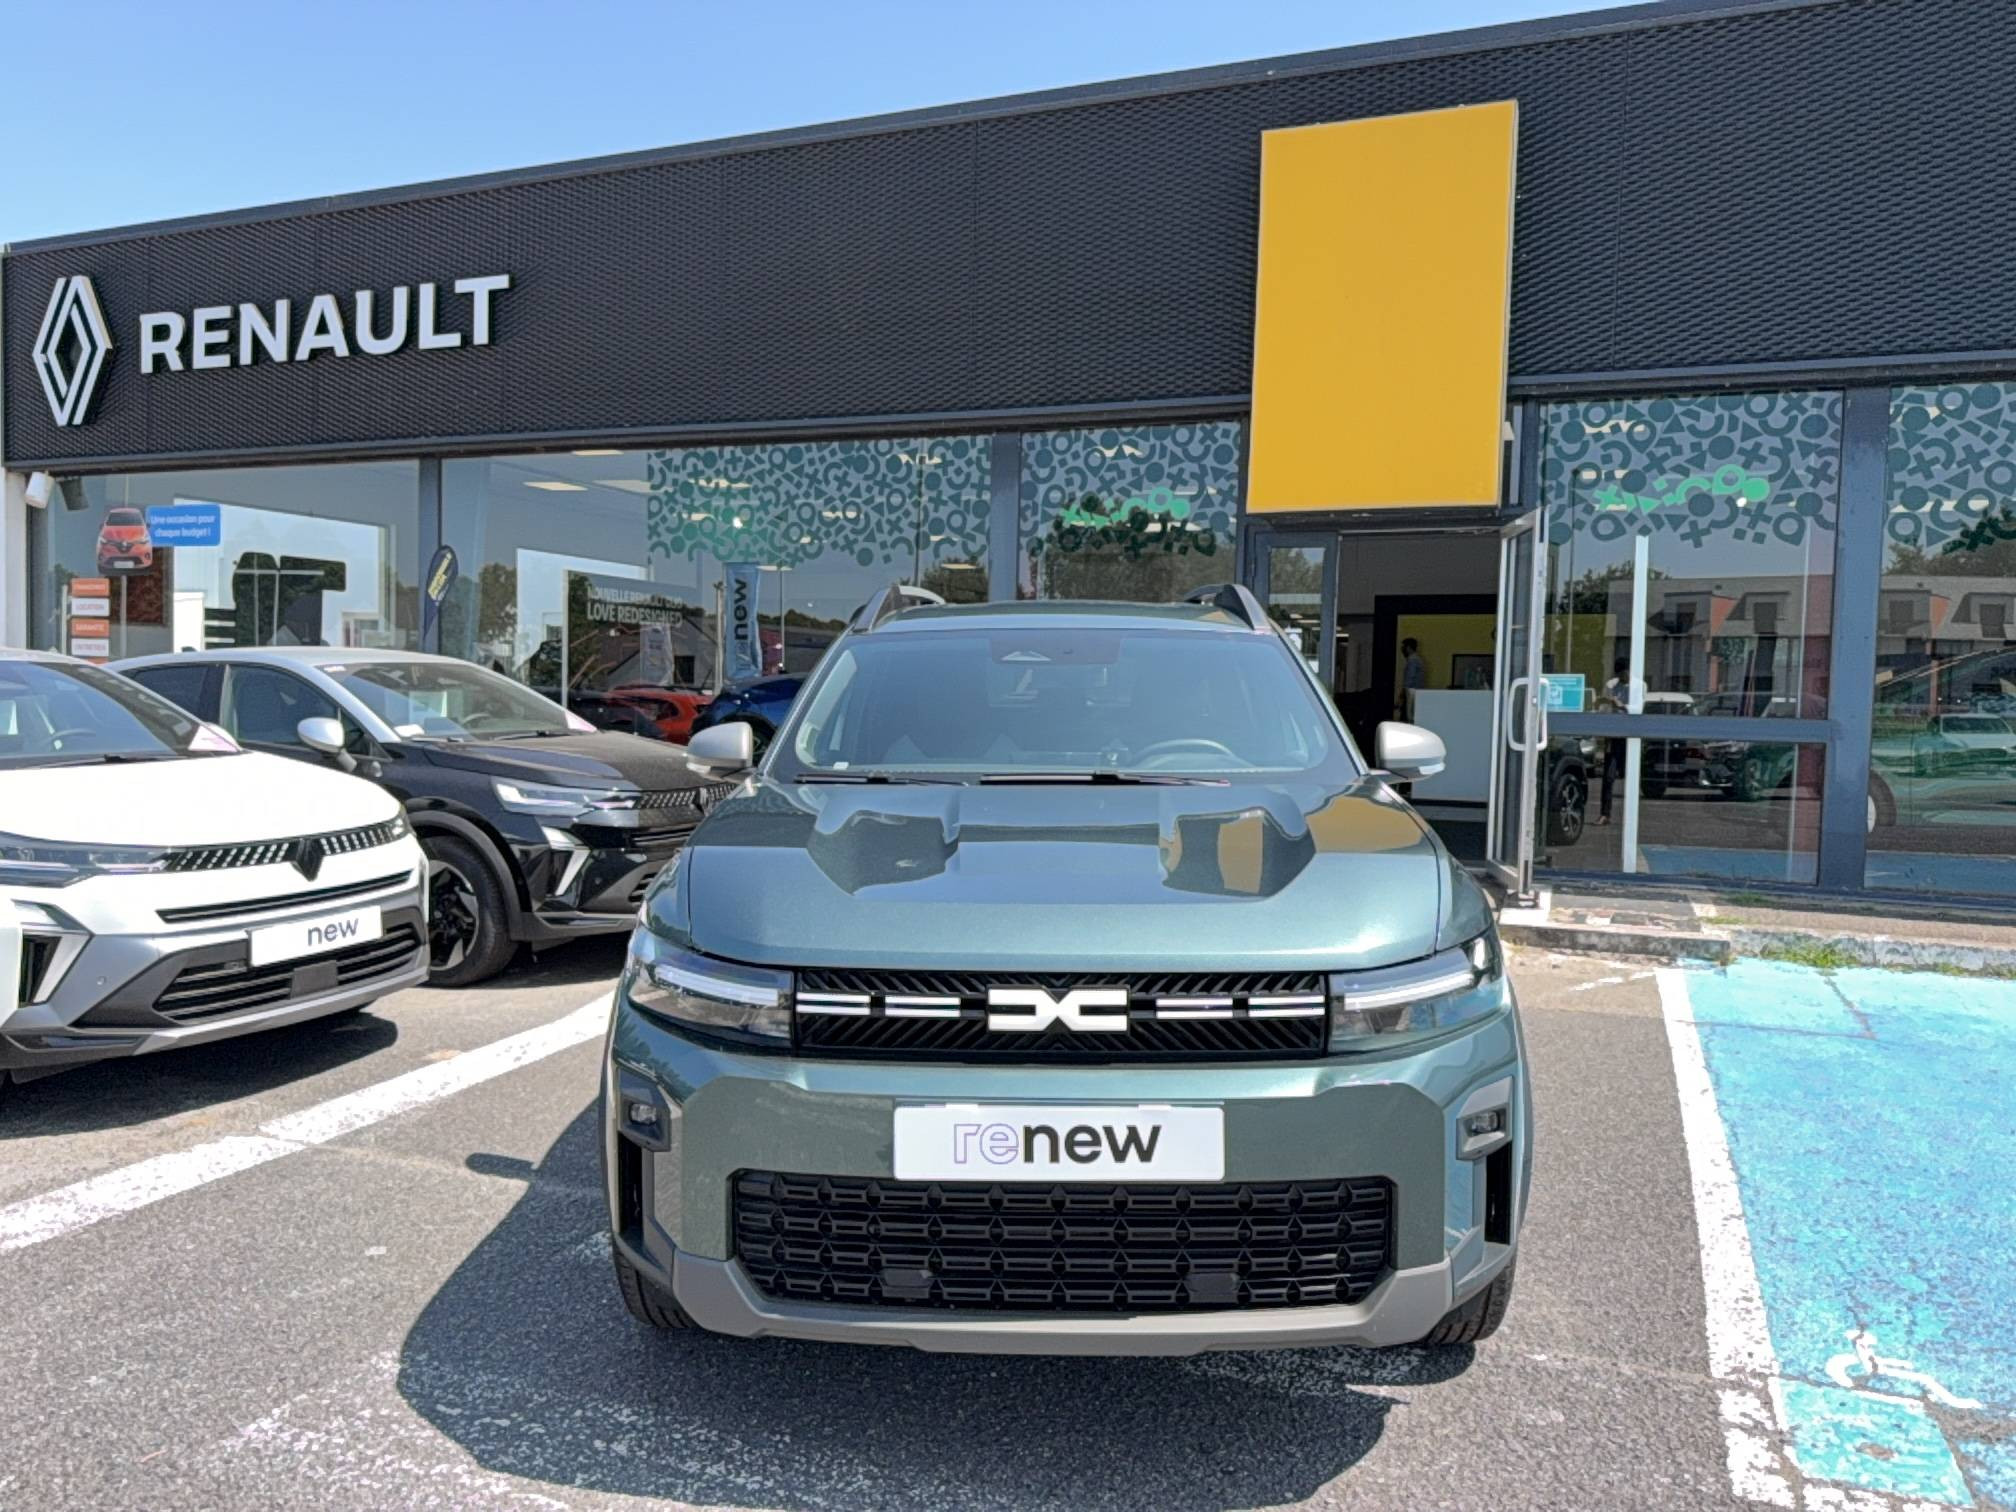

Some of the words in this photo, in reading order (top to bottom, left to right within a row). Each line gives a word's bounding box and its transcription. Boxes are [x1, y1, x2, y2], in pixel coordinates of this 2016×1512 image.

[139, 273, 510, 374] RENAULT
[587, 602, 616, 622] LOVE
[617, 606, 684, 628] REDESIGNED
[307, 917, 359, 946] new
[953, 1123, 1162, 1165] renew
